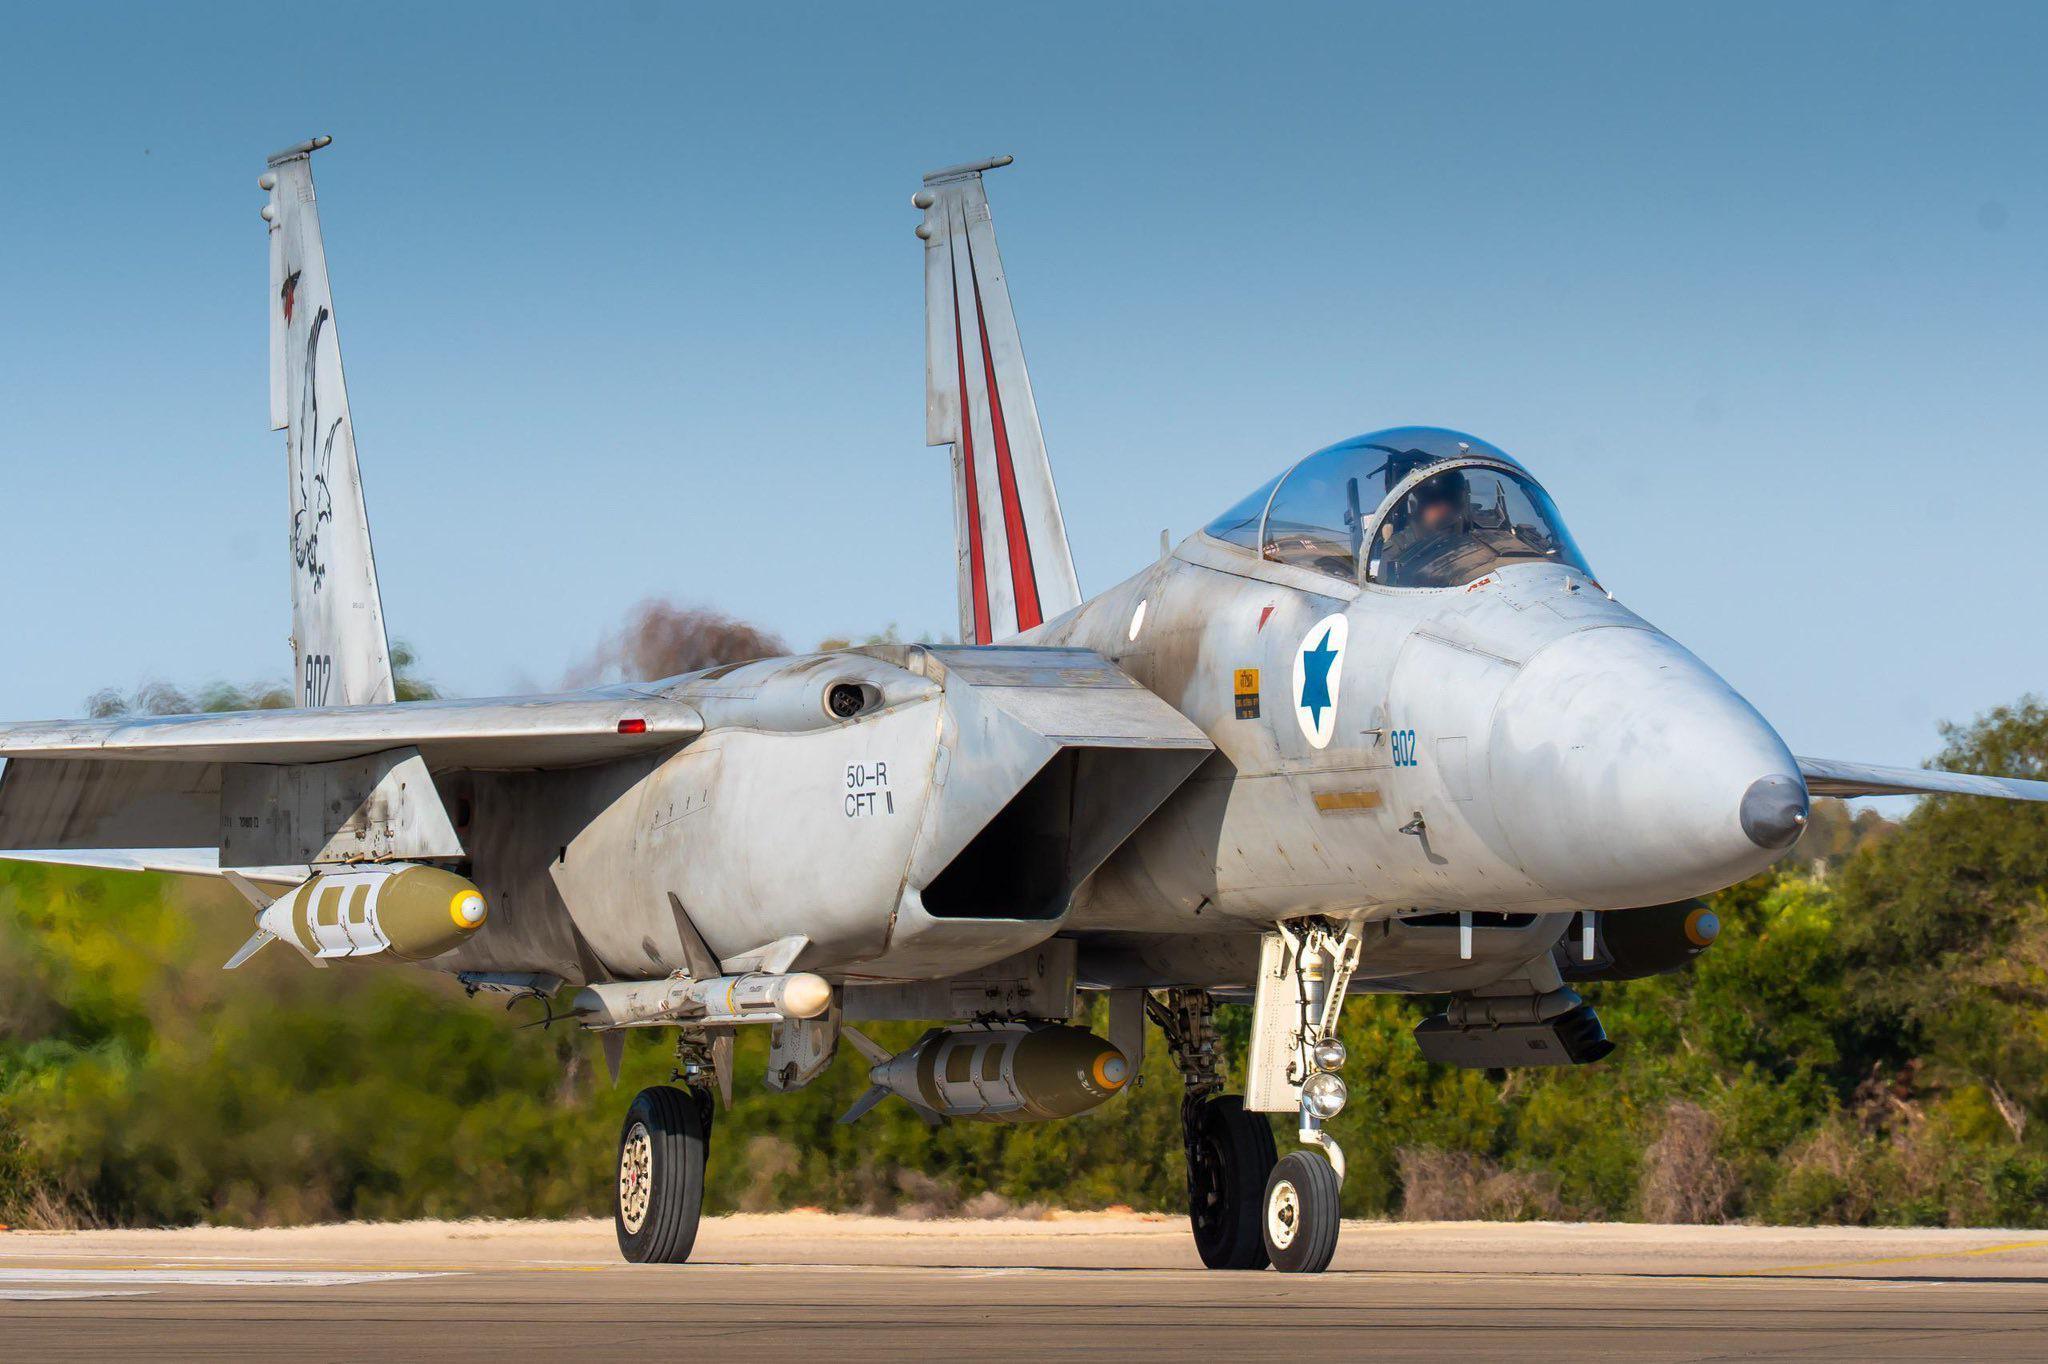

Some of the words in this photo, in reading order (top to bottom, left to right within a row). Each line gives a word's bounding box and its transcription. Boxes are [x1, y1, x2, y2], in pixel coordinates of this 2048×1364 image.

[305, 654, 331, 707] 802
[1391, 729, 1417, 767] 802
[846, 761, 888, 789] 50-R
[844, 792, 876, 818] CFT
